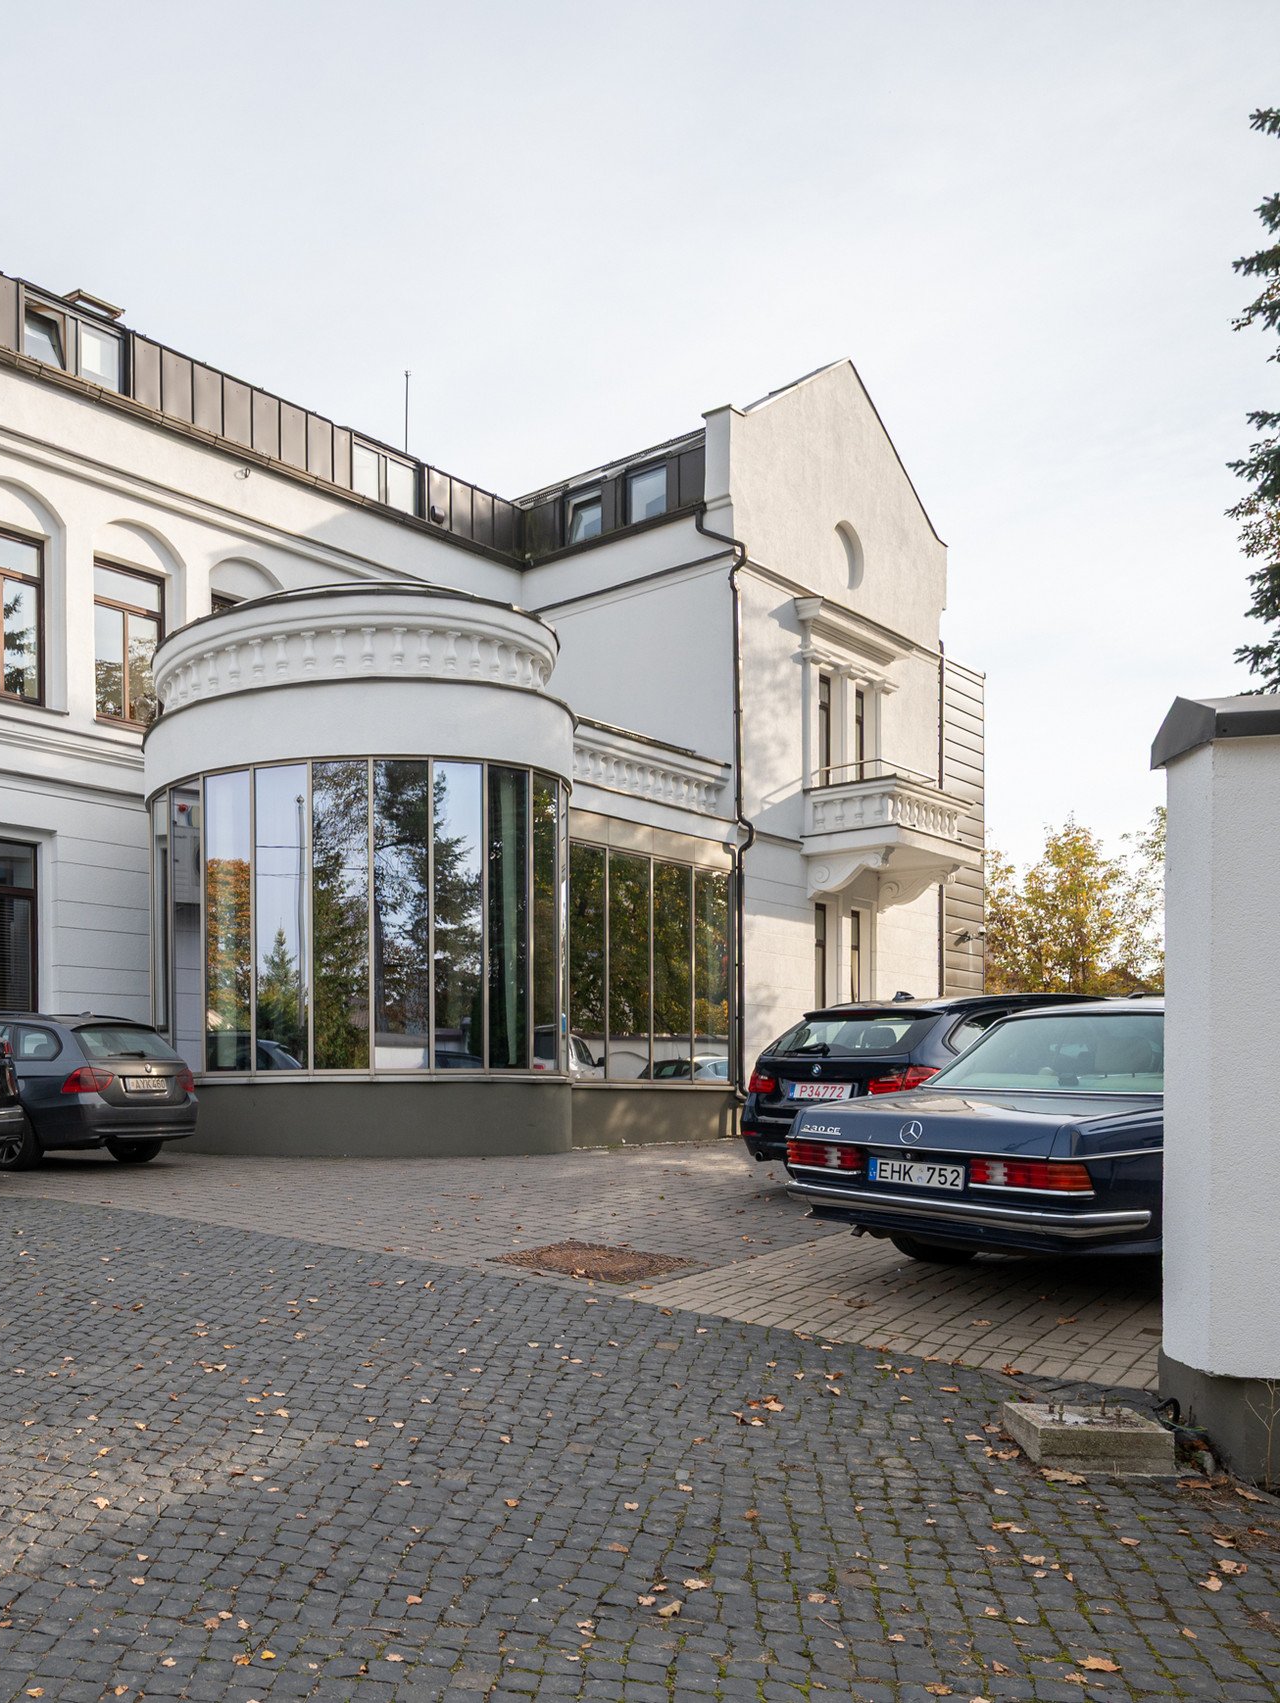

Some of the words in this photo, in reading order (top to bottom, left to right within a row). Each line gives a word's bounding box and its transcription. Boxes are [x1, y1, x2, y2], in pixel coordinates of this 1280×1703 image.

[799, 1085, 845, 1099] P34772
[878, 1161, 914, 1183] EHK
[925, 1166, 961, 1188] 752
